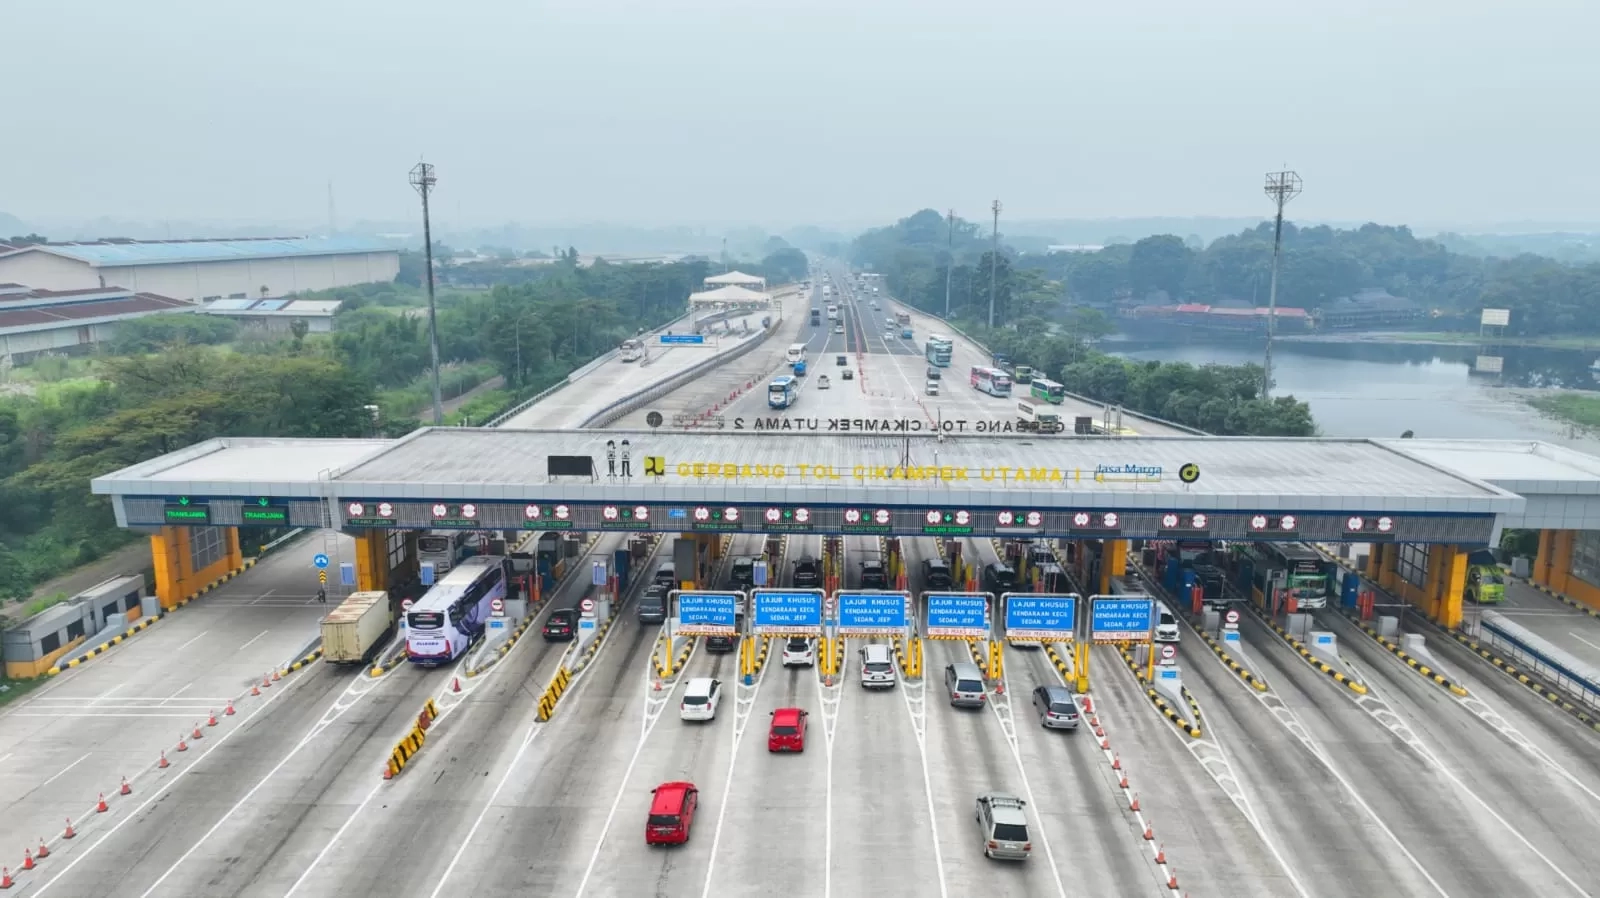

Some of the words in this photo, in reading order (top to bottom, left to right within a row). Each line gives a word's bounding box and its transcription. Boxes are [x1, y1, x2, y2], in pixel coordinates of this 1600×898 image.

[677, 462, 785, 480] GERBANG
[798, 464, 840, 480] TOL
[853, 464, 968, 481] CIKAMPEK
[981, 466, 1062, 482] UTAMA
[1098, 464, 1122, 474] Jasa
[1125, 464, 1162, 476] Marga
